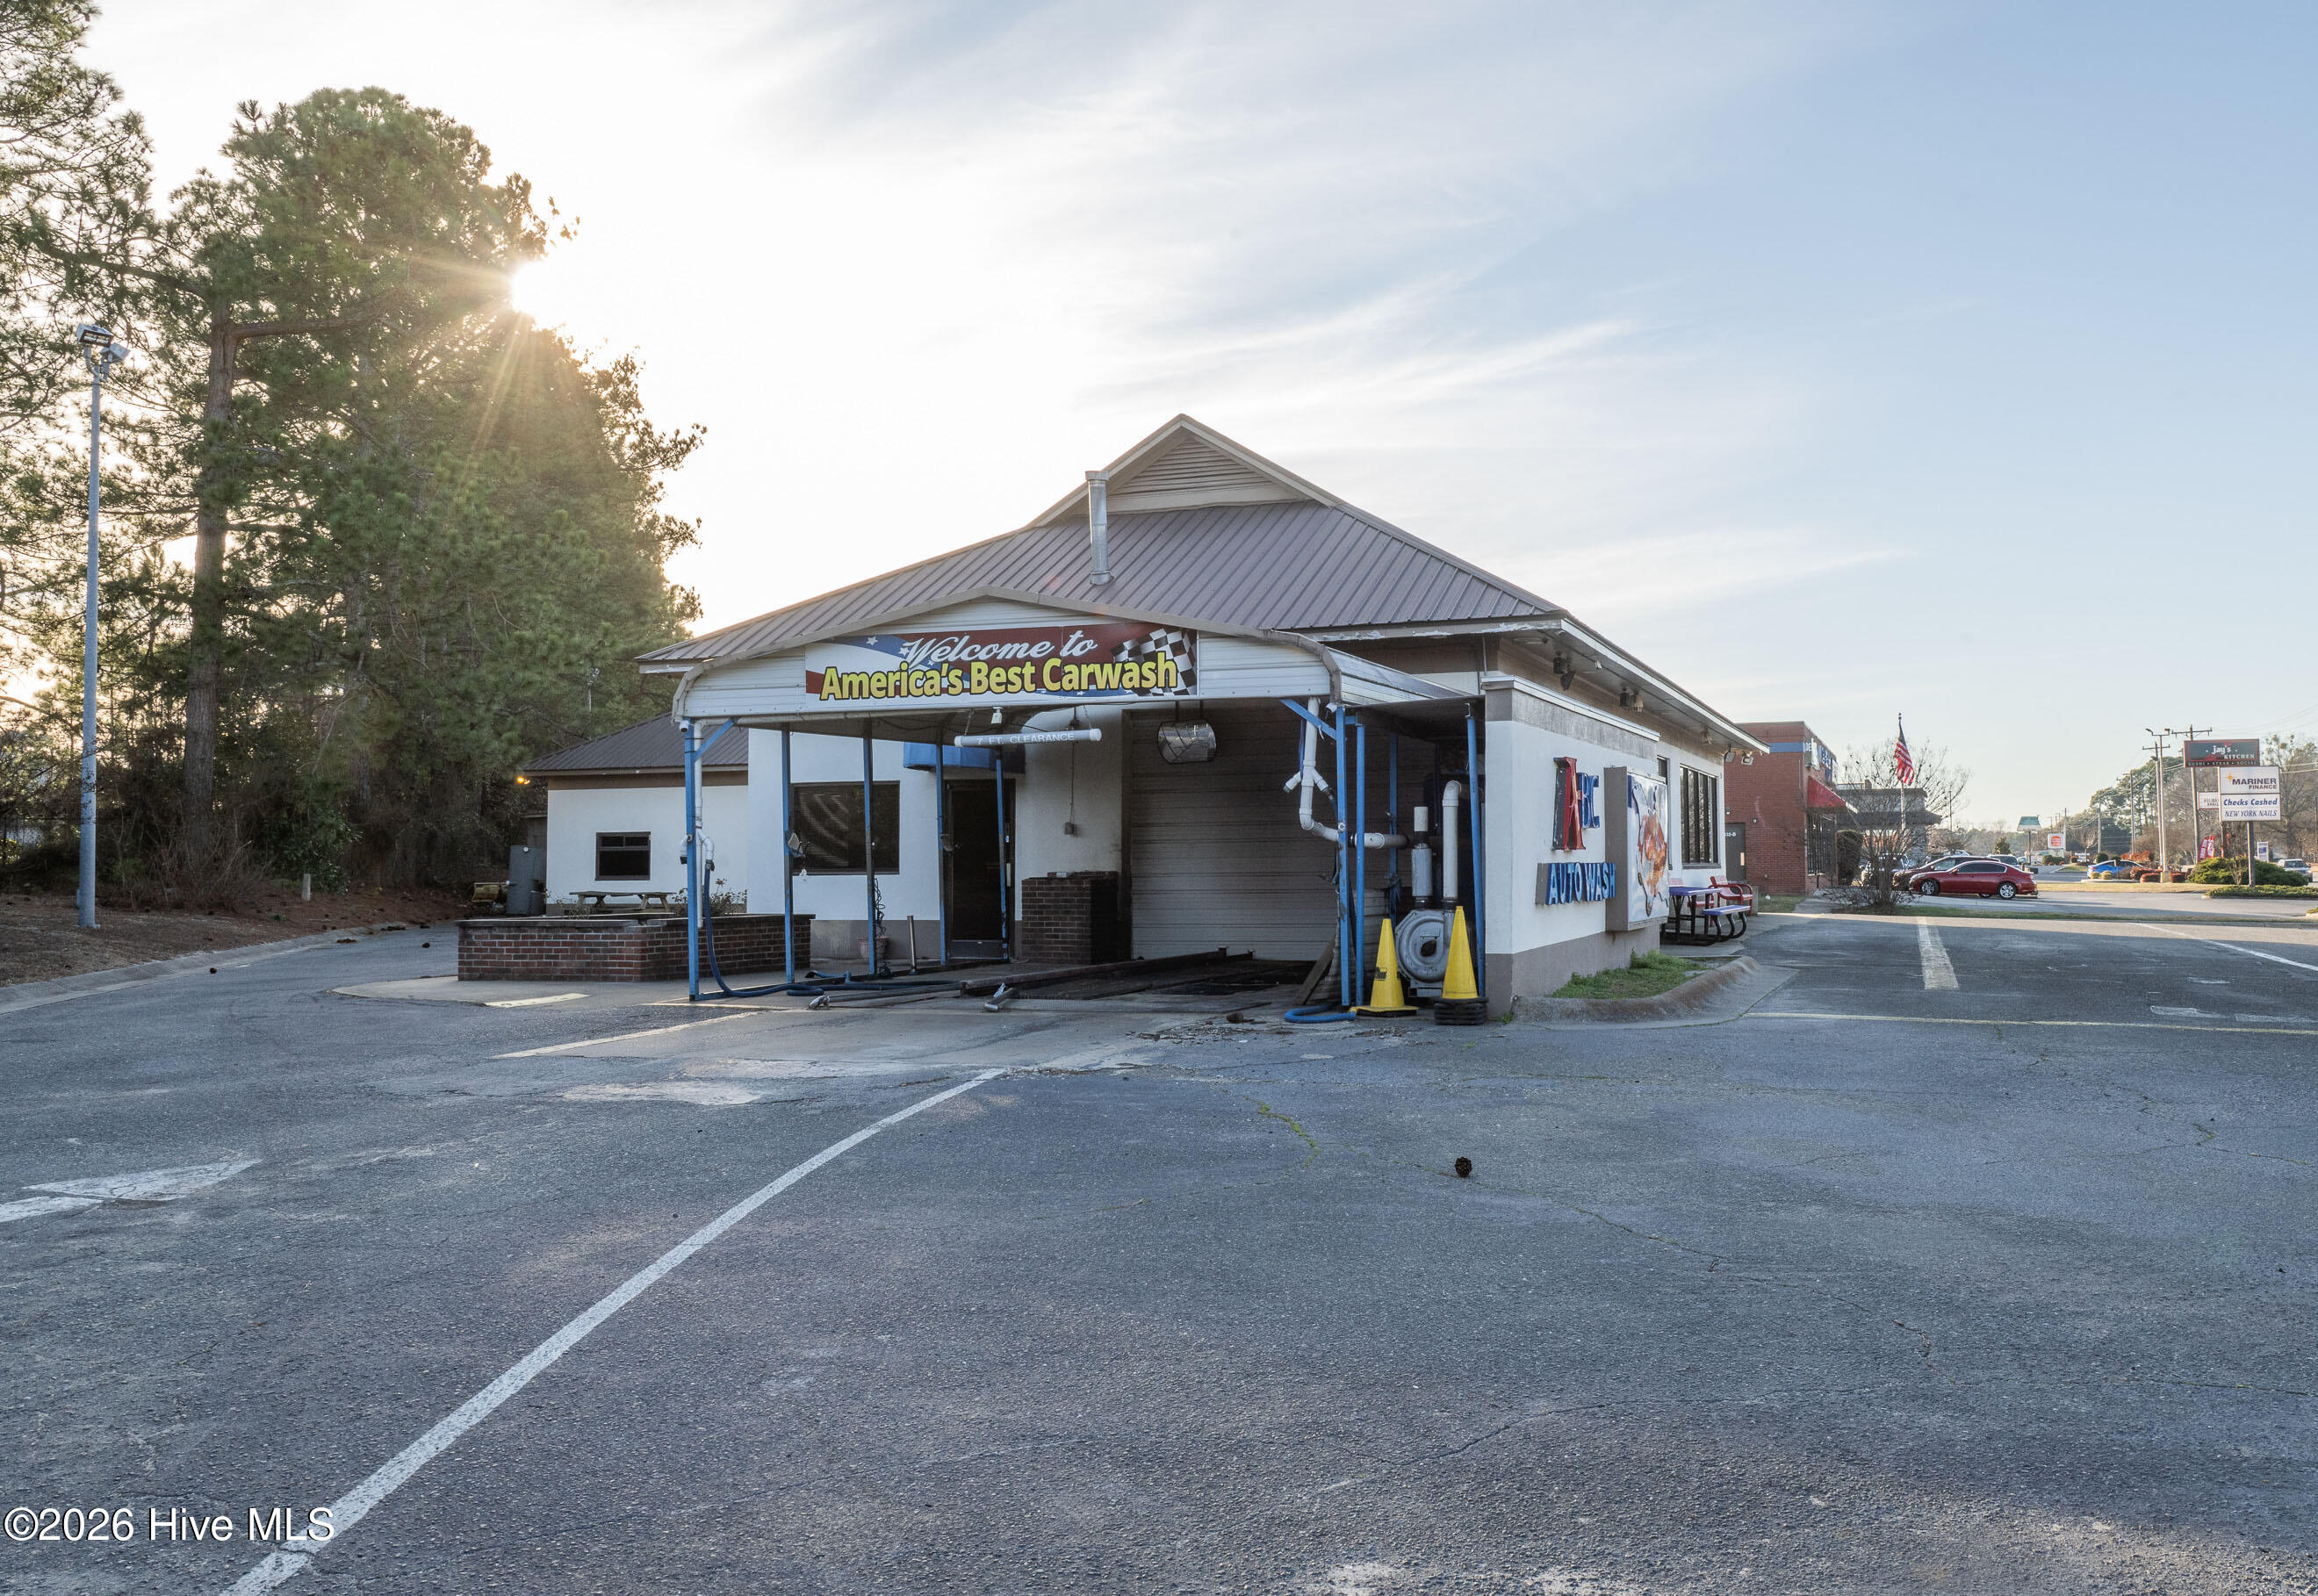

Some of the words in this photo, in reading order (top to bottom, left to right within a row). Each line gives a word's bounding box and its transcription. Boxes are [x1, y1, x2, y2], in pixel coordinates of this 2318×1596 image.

[902, 633, 1055, 672] Welcome
[1060, 629, 1098, 657] to
[820, 660, 964, 701] America's
[969, 660, 1037, 695] Best
[1041, 651, 1178, 693] Carwash
[1010, 732, 1076, 744] CLEARANCE
[2212, 745, 2231, 754] Jay's
[1545, 862, 1581, 905] AUTO
[1584, 862, 1616, 902] WASH
